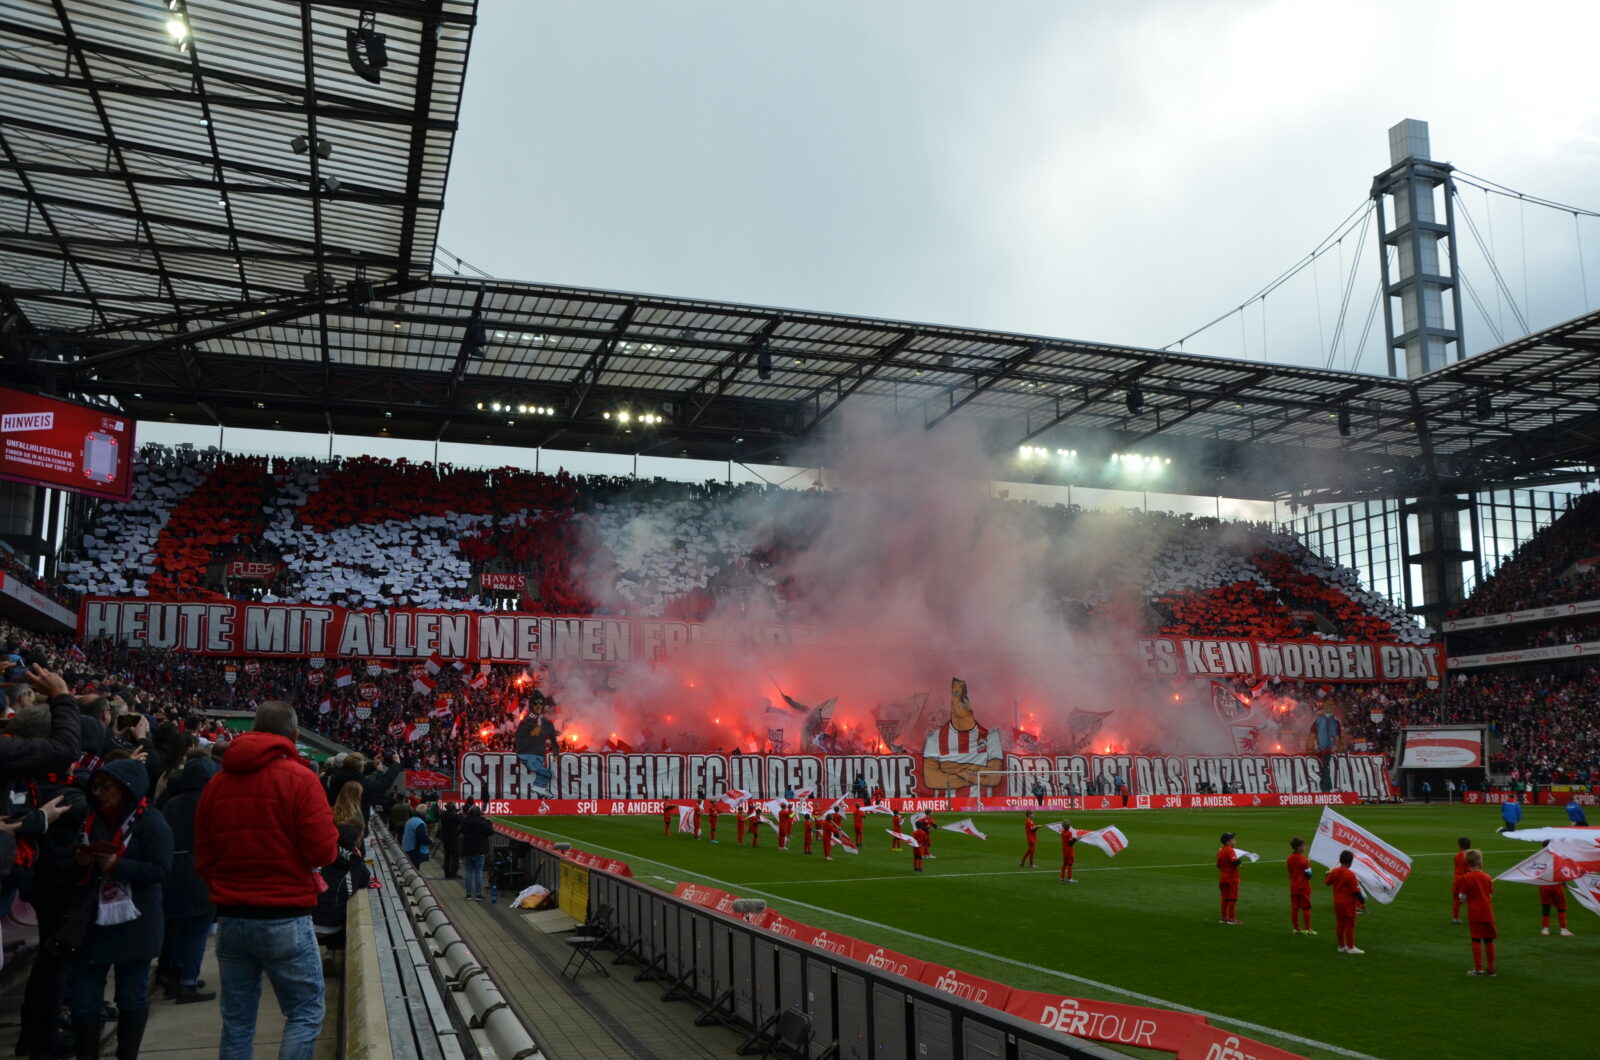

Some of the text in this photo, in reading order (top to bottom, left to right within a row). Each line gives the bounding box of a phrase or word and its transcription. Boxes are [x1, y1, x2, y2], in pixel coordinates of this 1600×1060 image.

[4, 415, 51, 429] HINWEIS
[6, 440, 72, 459] UNFALLHILFESTELLEN
[481, 573, 526, 587] HAWKS
[87, 602, 235, 652] HEUTE
[245, 605, 333, 654] MIT
[338, 611, 469, 659] ALLEN
[479, 616, 633, 661] MEINEN
[1138, 638, 1439, 680] ES KEIN MORGEN GIBT
[608, 754, 685, 800] BEIM
[688, 755, 728, 800] FC
[730, 756, 763, 800] IN
[767, 757, 821, 800] DER
[825, 756, 916, 799] KURVE
[1007, 756, 1054, 797] DER
[1056, 756, 1088, 796] FC
[1092, 756, 1133, 796] IST
[1135, 756, 1185, 796] DAS
[1187, 756, 1271, 795] EINZIGE
[1272, 755, 1323, 795] WAS
[1279, 794, 1345, 805] SPÜRBAR ANDERS.
[1039, 1000, 1157, 1047] DERTOUR
